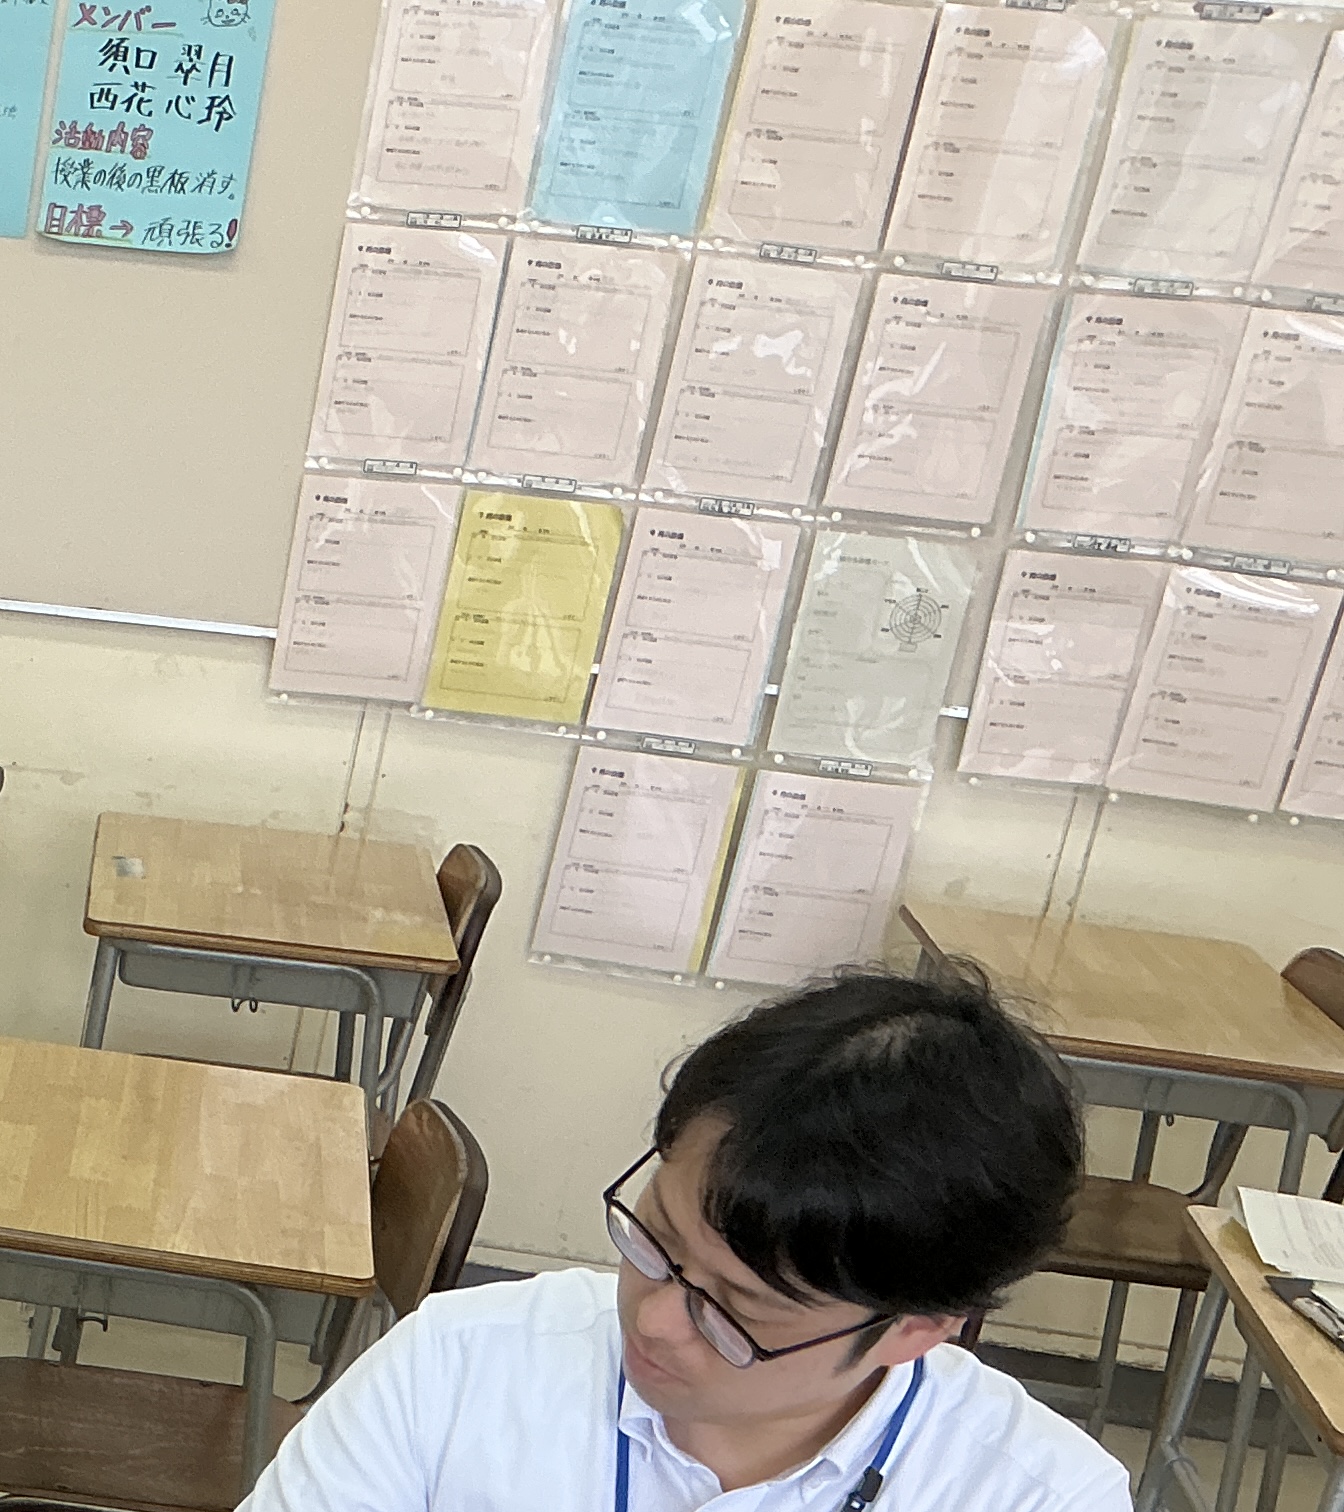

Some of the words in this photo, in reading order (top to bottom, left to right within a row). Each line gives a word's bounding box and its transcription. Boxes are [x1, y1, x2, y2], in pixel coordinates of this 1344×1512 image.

[74, 3, 177, 32] メンバー
[89, 81, 156, 117] 西花
[52, 120, 153, 159] 活動内容
[45, 203, 106, 239] 目標
